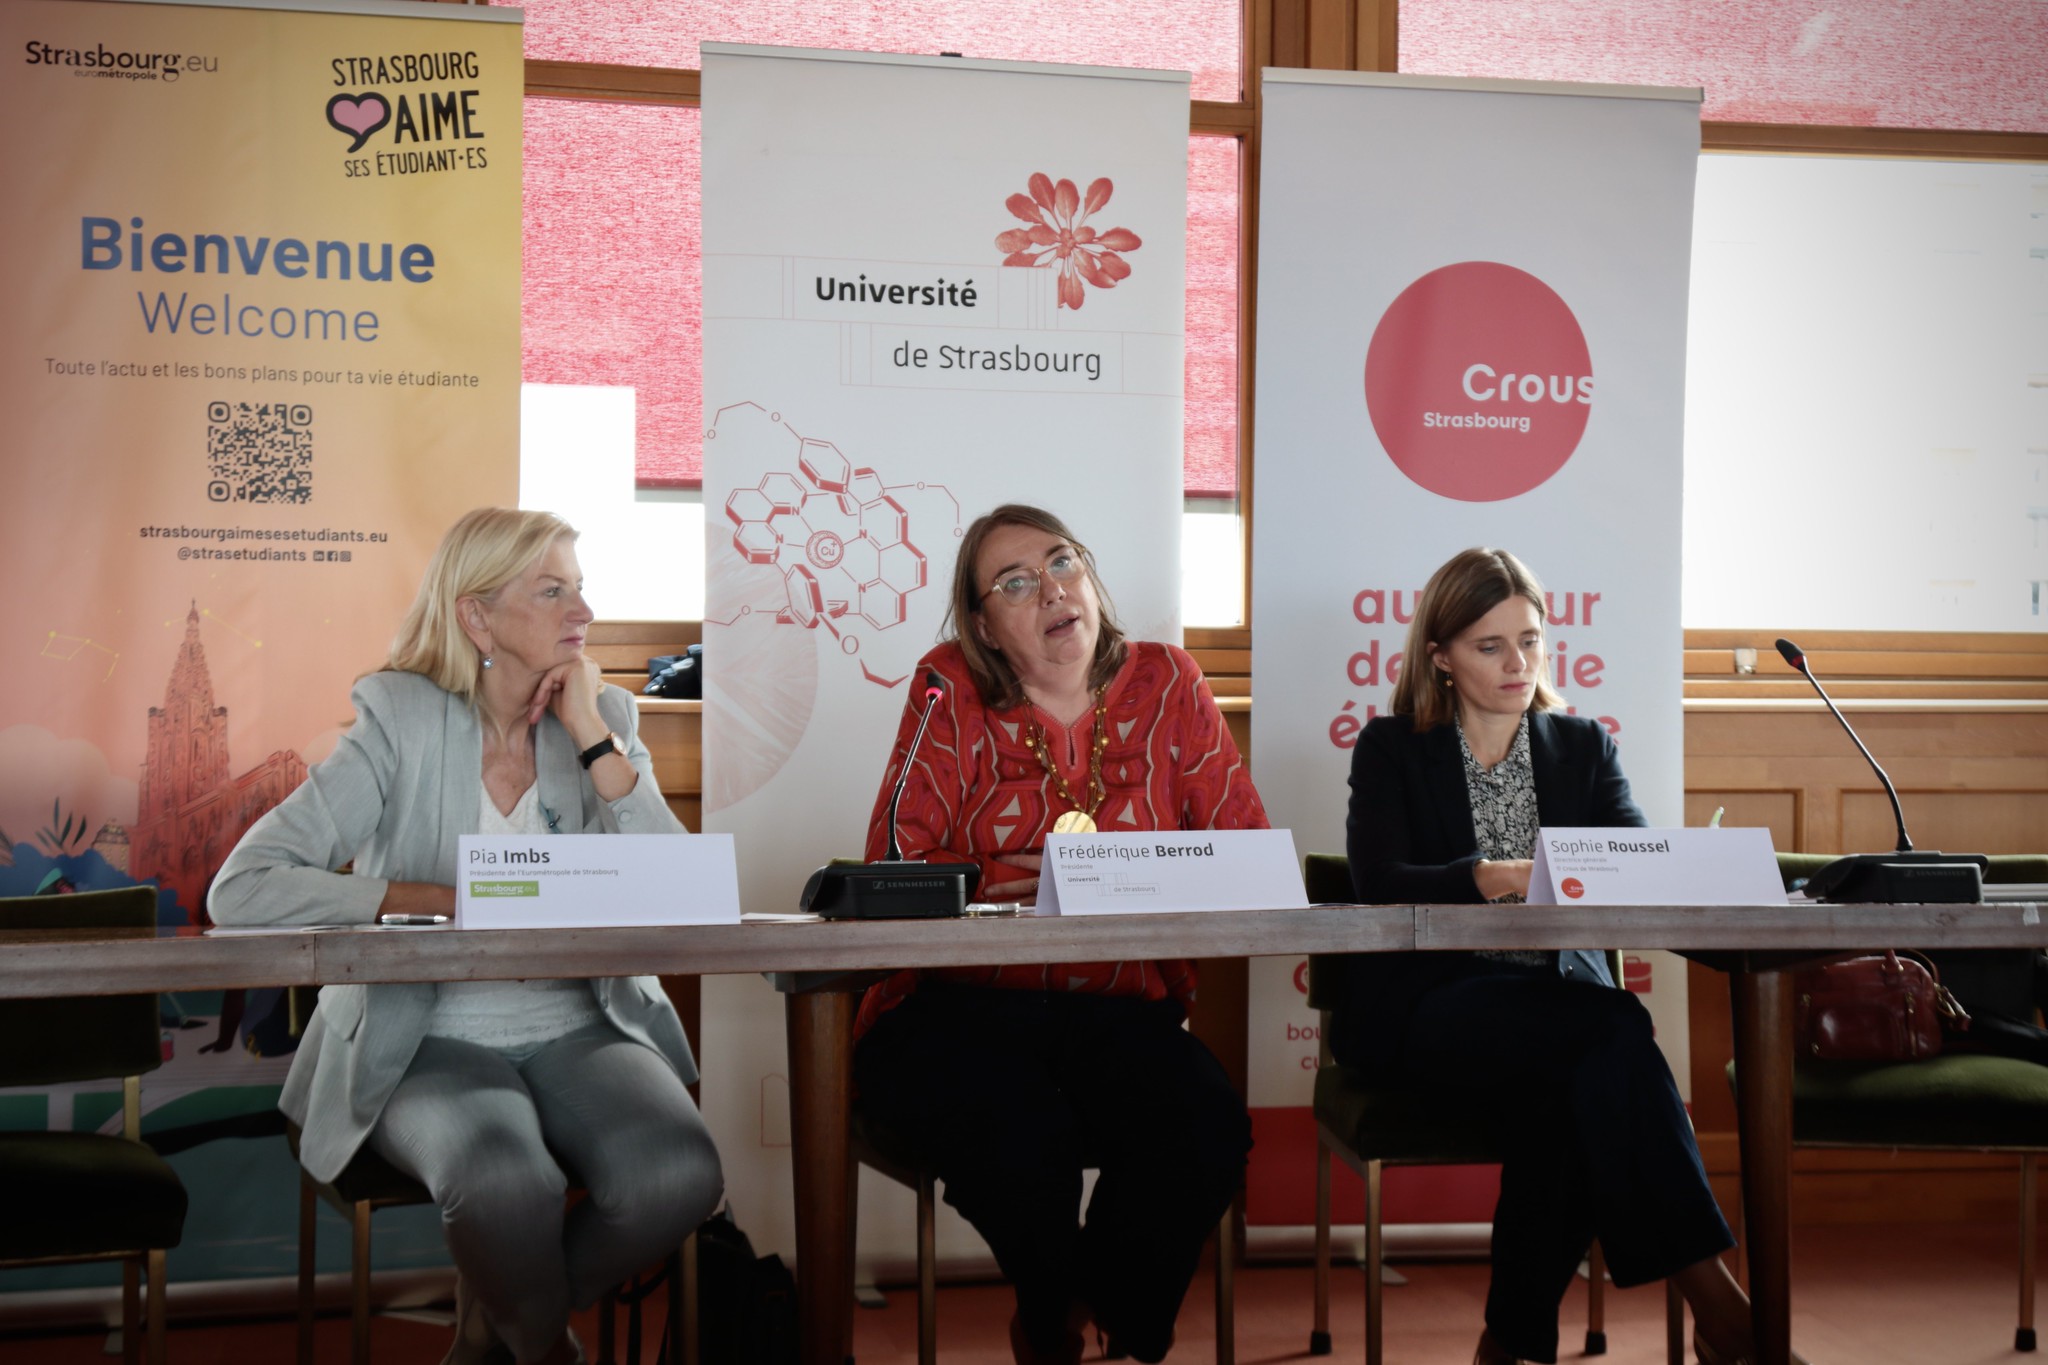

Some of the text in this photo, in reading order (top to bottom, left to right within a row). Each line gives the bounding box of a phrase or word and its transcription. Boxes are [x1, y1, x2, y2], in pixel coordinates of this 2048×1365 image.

[26, 41, 218, 82] Strasbourg.eu
[74, 69, 157, 81] eurométropole
[332, 51, 479, 86] STRASBOURG
[394, 90, 485, 144] AIME
[344, 159, 370, 178] SES
[81, 216, 436, 283] Bienvenue
[815, 274, 978, 307] Université
[137, 291, 379, 342] Welcome
[45, 358, 96, 376] Toute
[152, 364, 169, 377] et
[174, 363, 199, 378] les
[204, 363, 247, 380] bons
[251, 365, 298, 383] plans
[303, 371, 342, 386] pour
[347, 371, 364, 384] ta
[369, 370, 393, 385] vie
[398, 371, 479, 387] étudiante
[893, 341, 1101, 381] de Strasbourg
[1462, 363, 1596, 404] Crous
[1423, 412, 1531, 432] Strasbourg
[140, 526, 388, 542] strasbourgaimesesetudiants.eu
[177, 547, 306, 562] @strasetudiants
[1353, 589, 1601, 626] auur
[1547, 640, 1605, 688] ie
[470, 848, 550, 864] Pia Imbs
[1059, 842, 1214, 861] Frédérique Berrod
[1551, 839, 1670, 856] Sophie Roussel
[1123, 885, 1156, 893] Strasbourg
